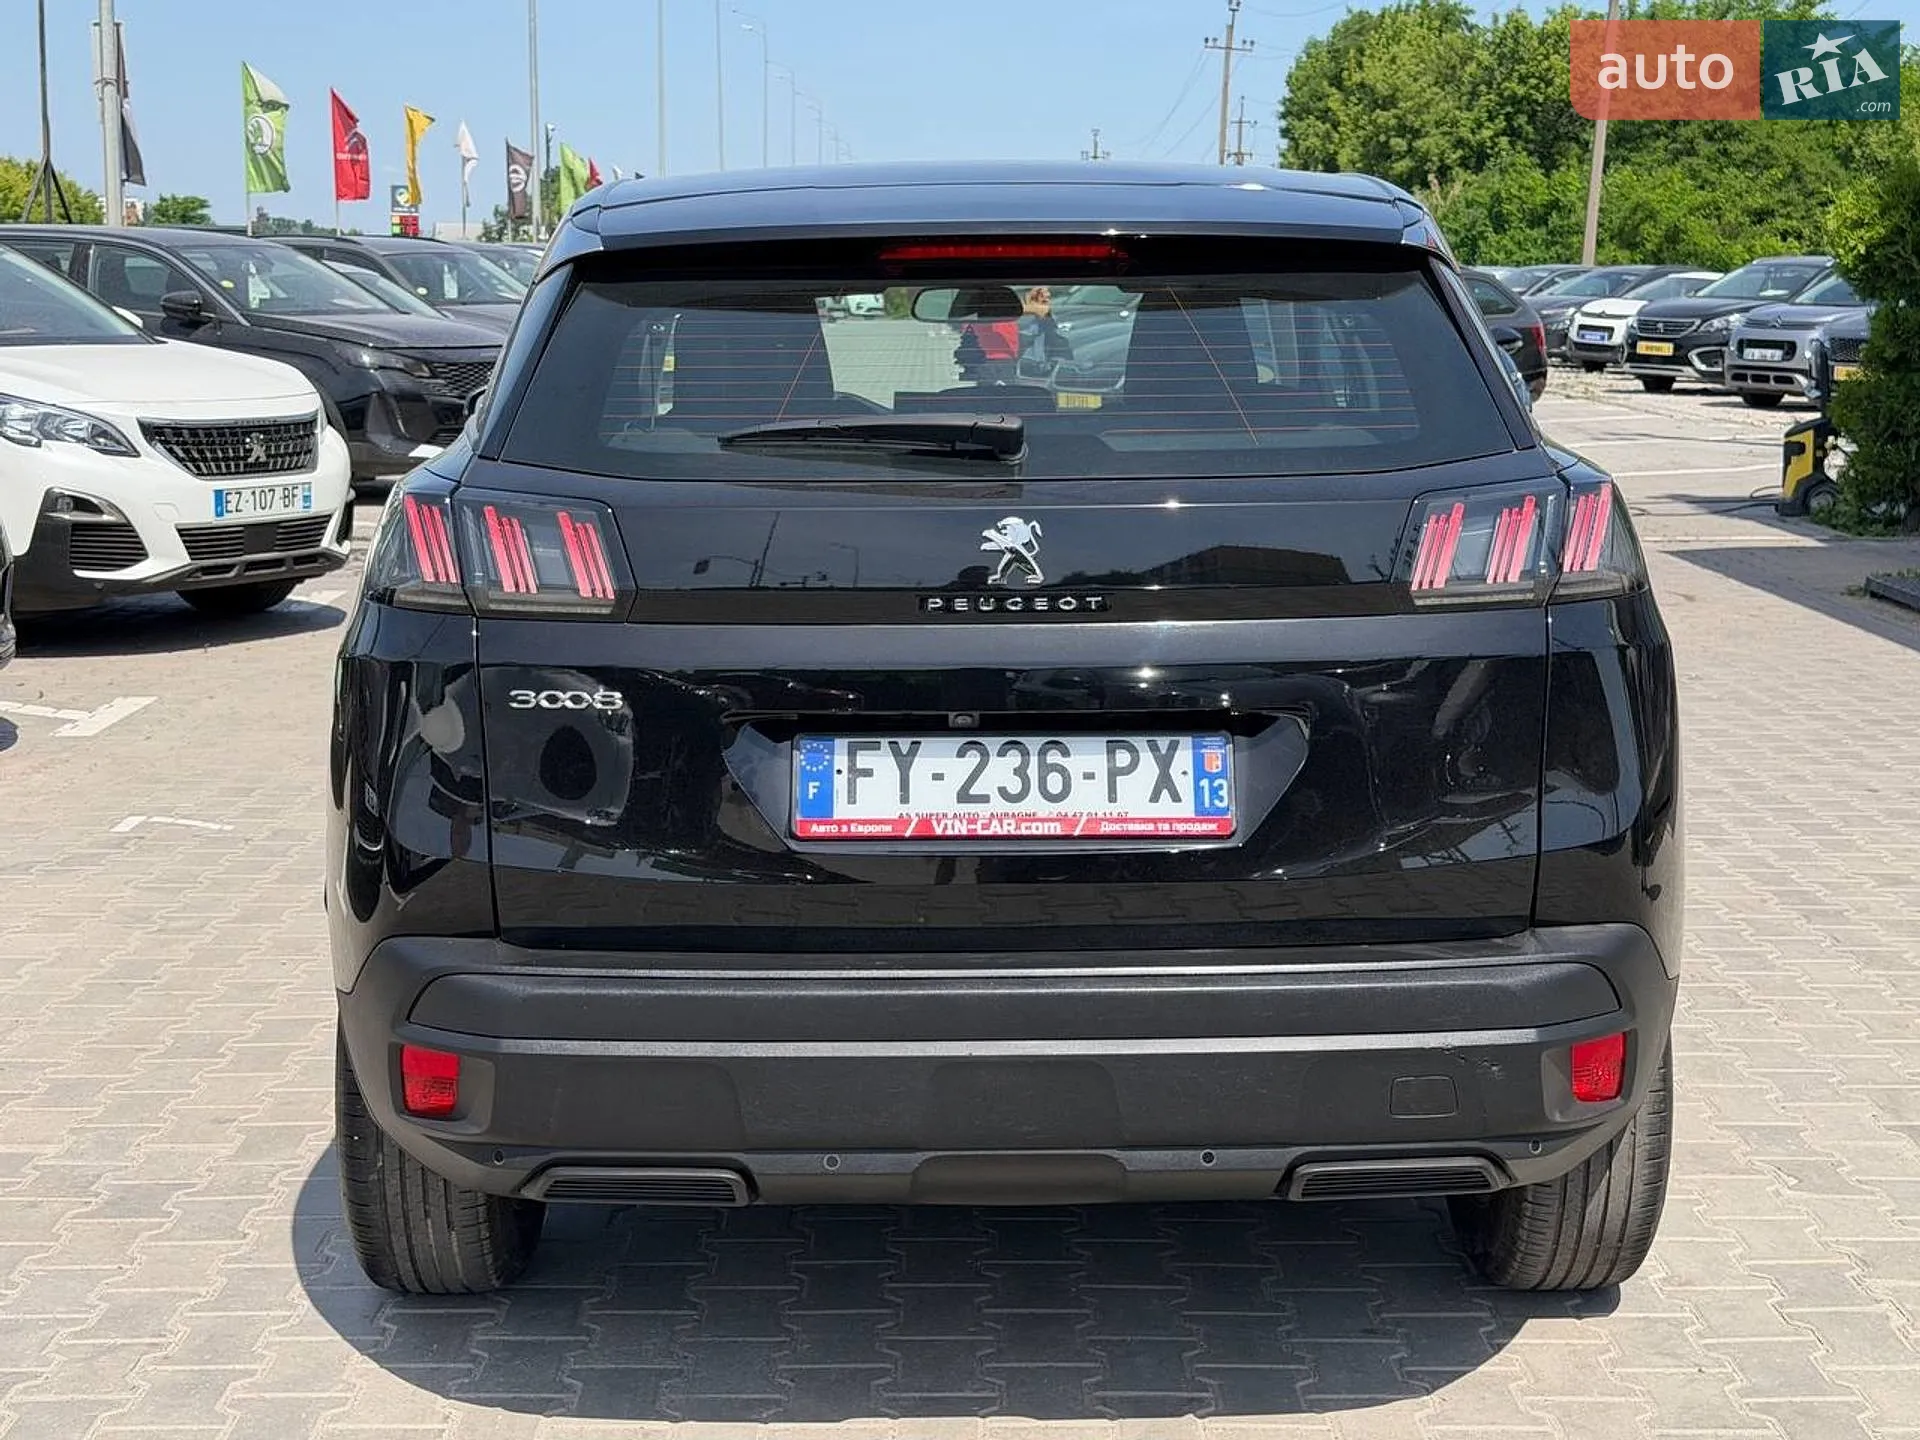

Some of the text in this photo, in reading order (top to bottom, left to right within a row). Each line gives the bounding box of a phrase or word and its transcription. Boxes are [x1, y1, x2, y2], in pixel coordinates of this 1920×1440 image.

[928, 597, 1102, 611] PEUGEOT
[509, 690, 623, 709] 3008
[847, 741, 1182, 803] FY-236-PX
[808, 781, 820, 799] F
[1199, 778, 1228, 808] 13
[810, 823, 838, 833] Авто
[932, 818, 1061, 836] VIN-CAR.com
[1100, 821, 1154, 833] Доставка
